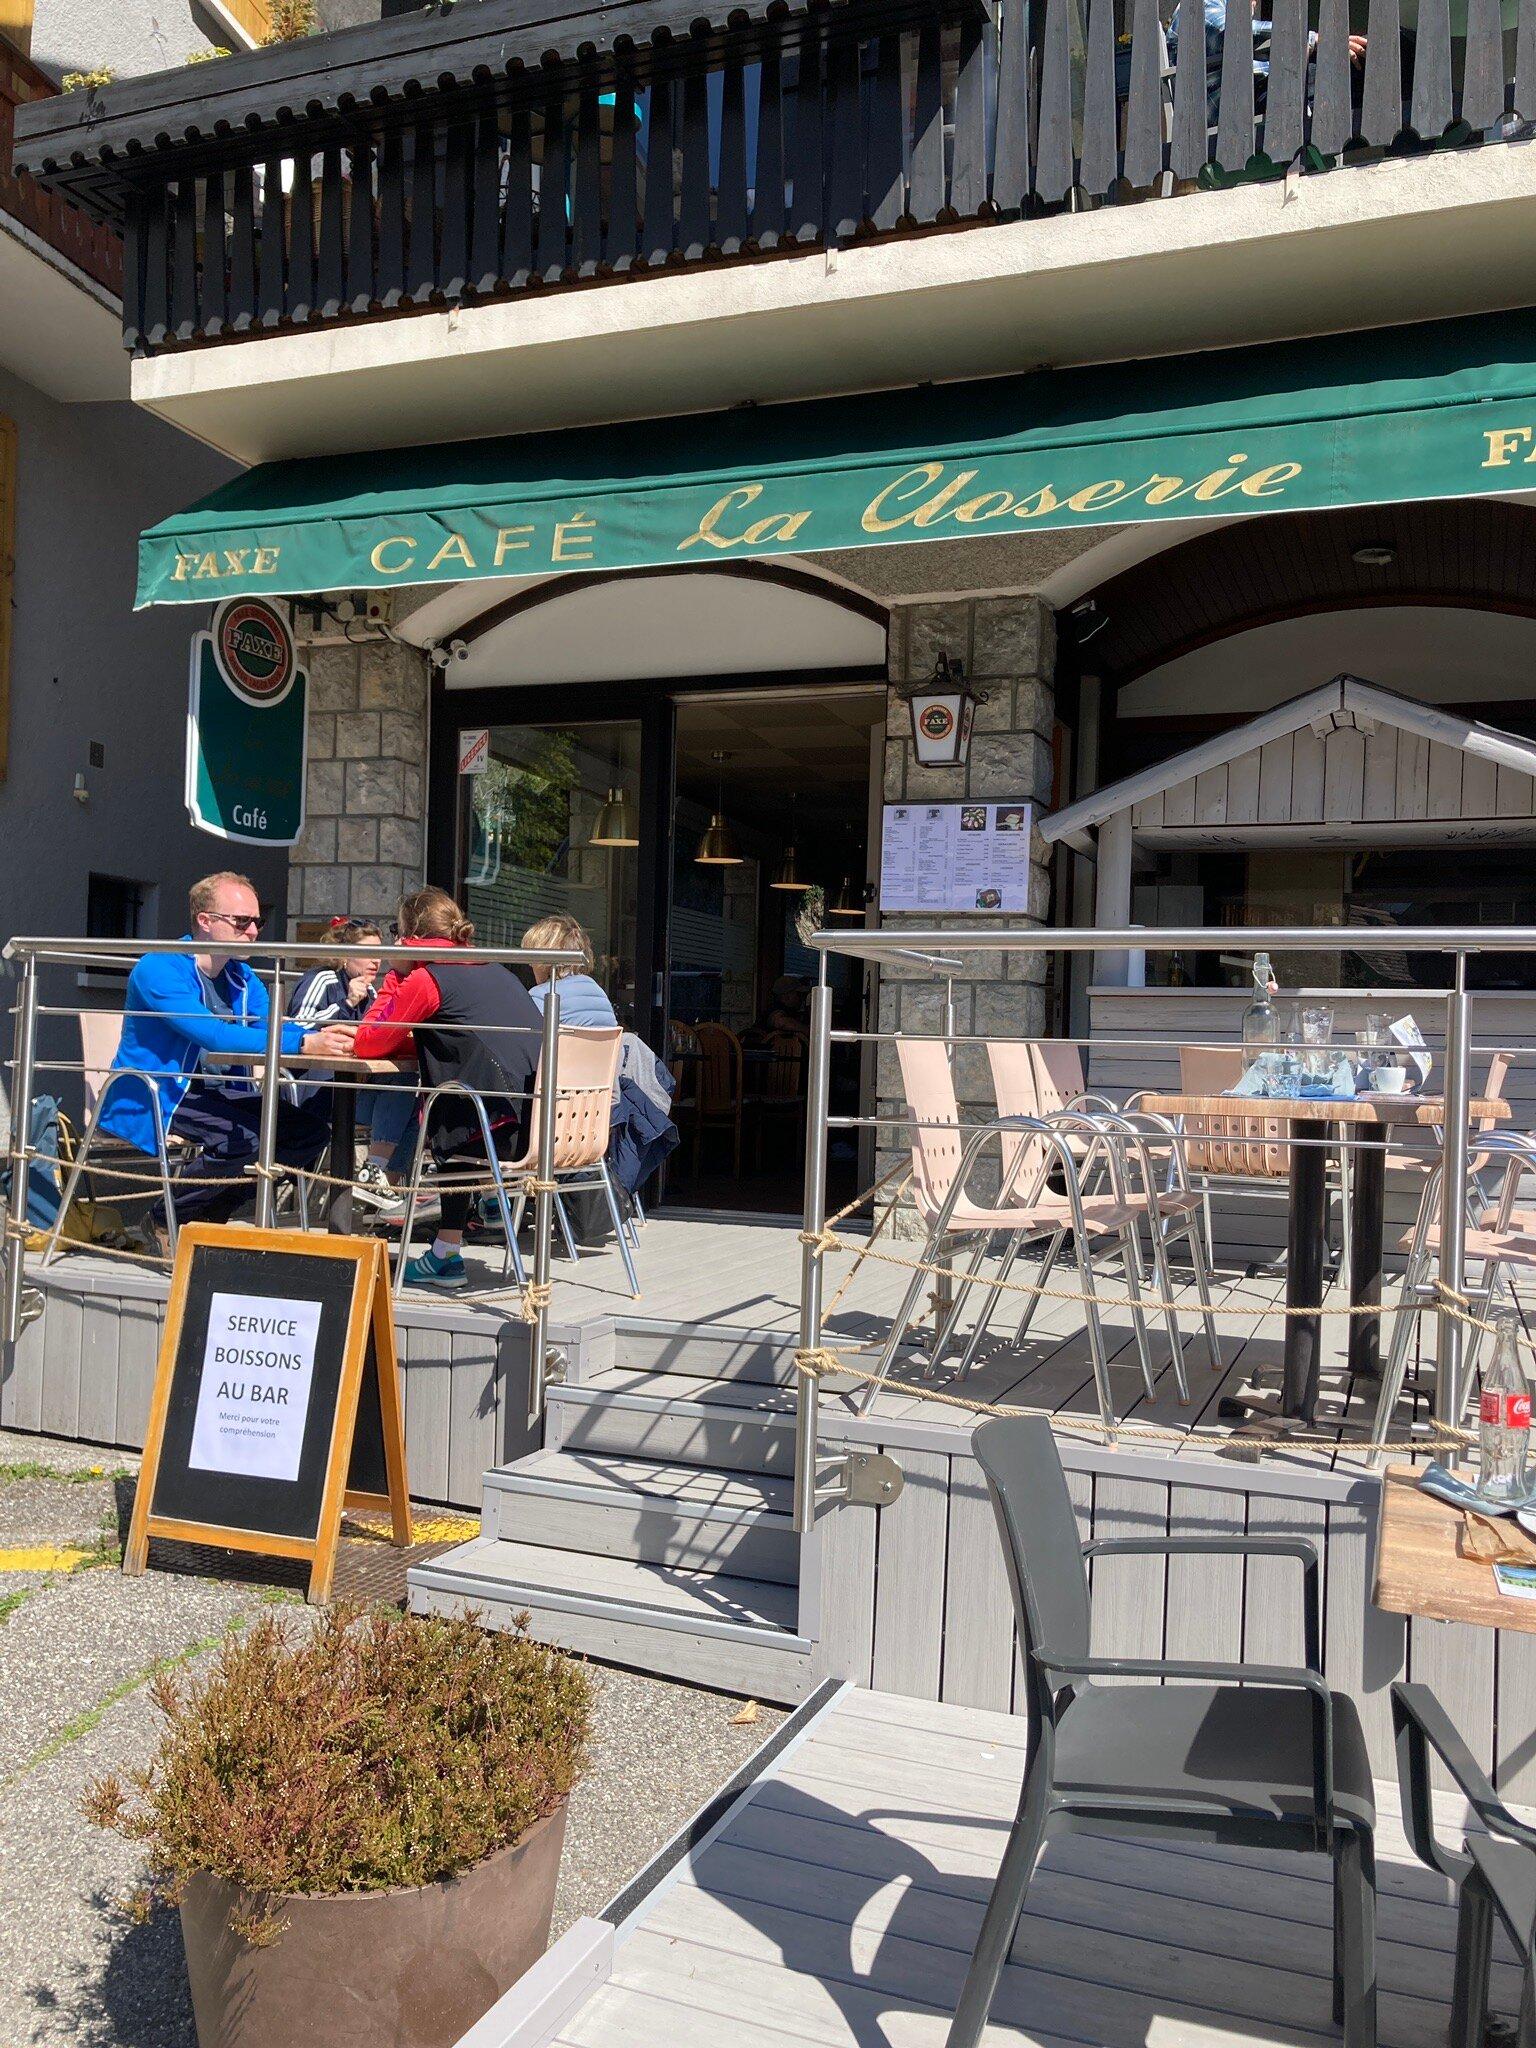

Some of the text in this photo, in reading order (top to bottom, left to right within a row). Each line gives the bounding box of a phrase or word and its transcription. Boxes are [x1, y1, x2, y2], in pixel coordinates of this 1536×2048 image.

[169, 426, 1536, 582] FAXE CAFÉ La Closerie F
[227, 627, 284, 664] FAXE
[924, 717, 948, 726] FAXE
[232, 804, 268, 830] Café
[227, 1315, 298, 1336] SERVICE
[214, 1347, 302, 1370] BOISSONS
[216, 1381, 289, 1405] AU BAR
[219, 1411, 280, 1426] Merci pour votre
[219, 1426, 276, 1438] compréhension
